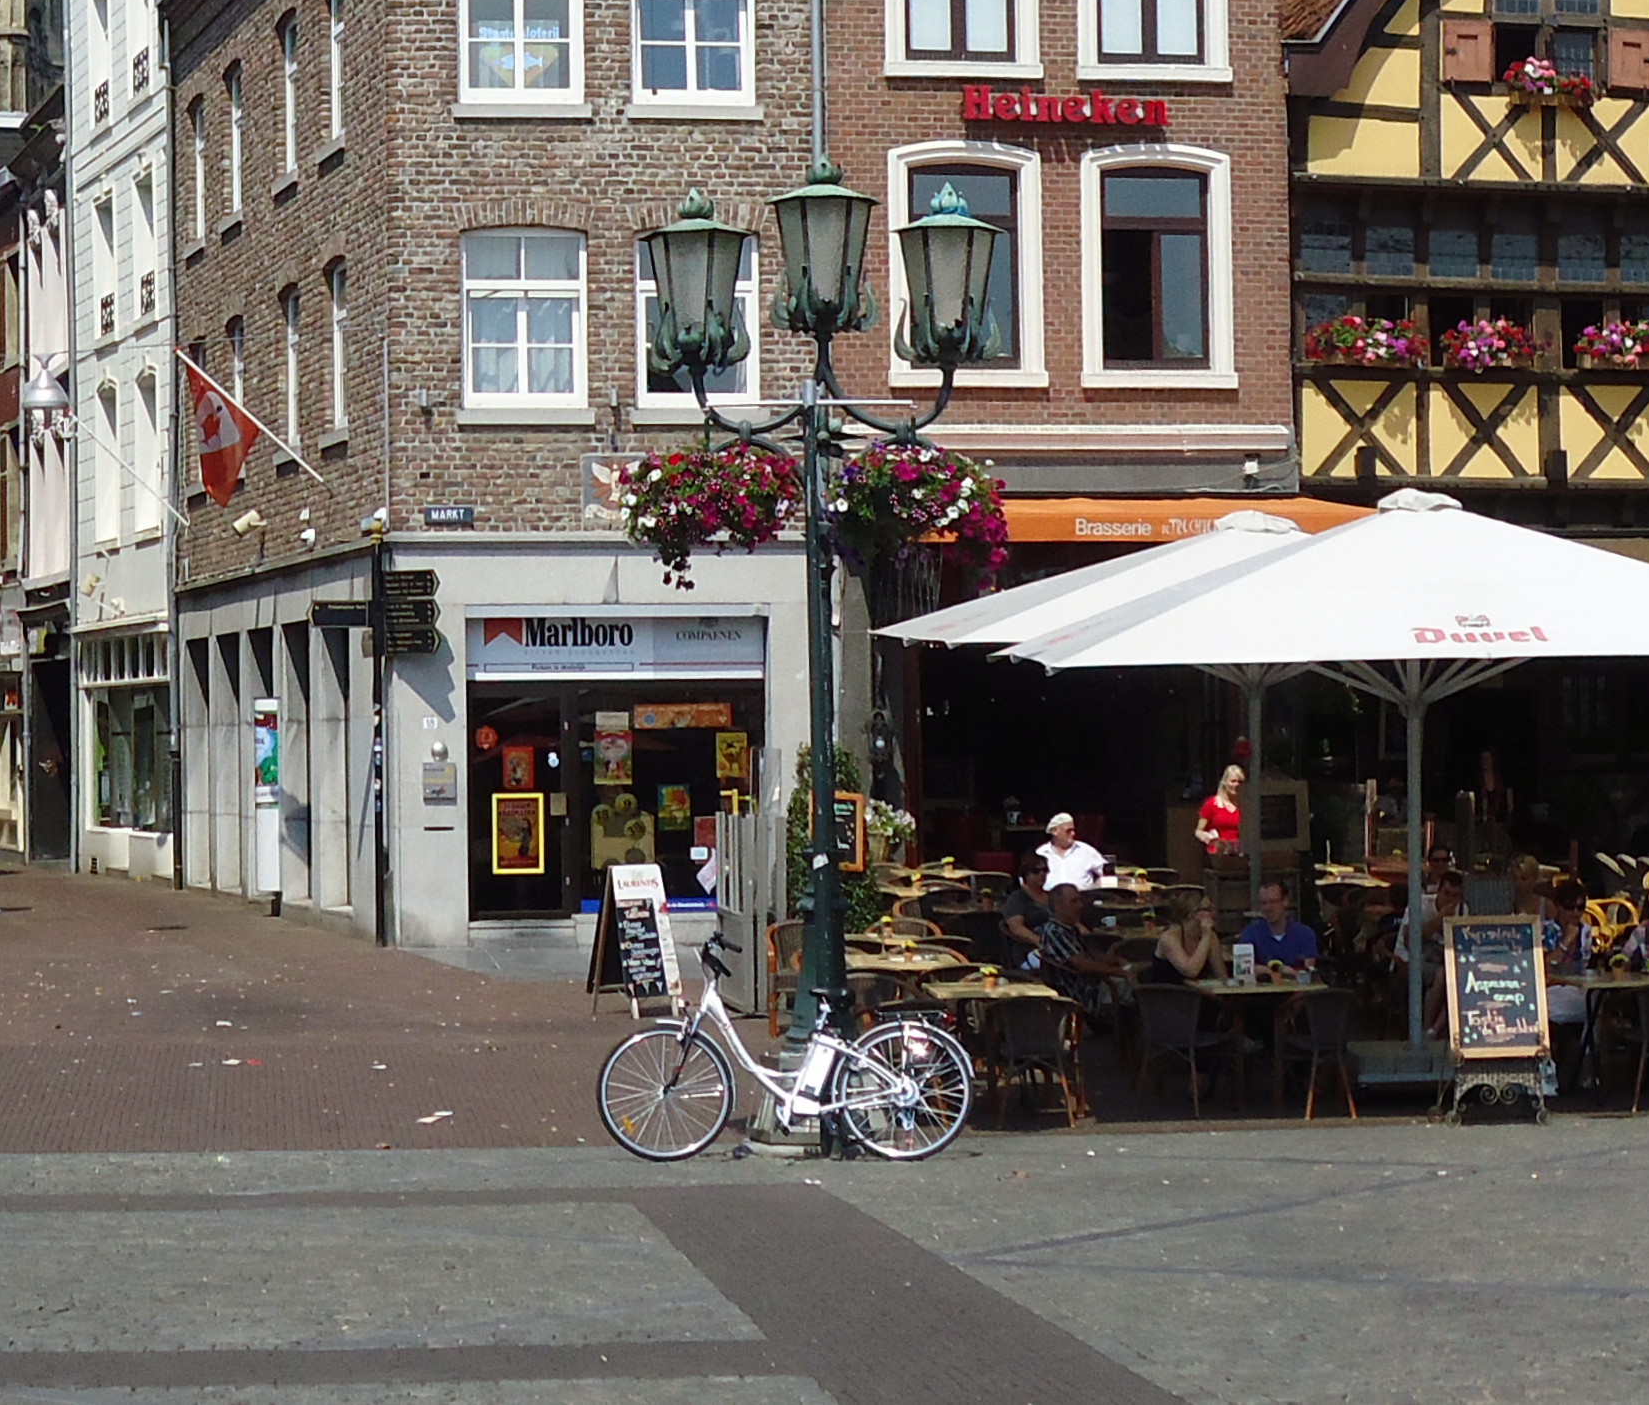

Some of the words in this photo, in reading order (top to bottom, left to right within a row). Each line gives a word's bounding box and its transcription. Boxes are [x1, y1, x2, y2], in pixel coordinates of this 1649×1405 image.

[962, 84, 1170, 127] Heineken
[431, 509, 465, 520] MARKT
[1075, 518, 1152, 536] Brasserie
[524, 618, 634, 647] Marlboro
[1411, 626, 1548, 644] Duvel
